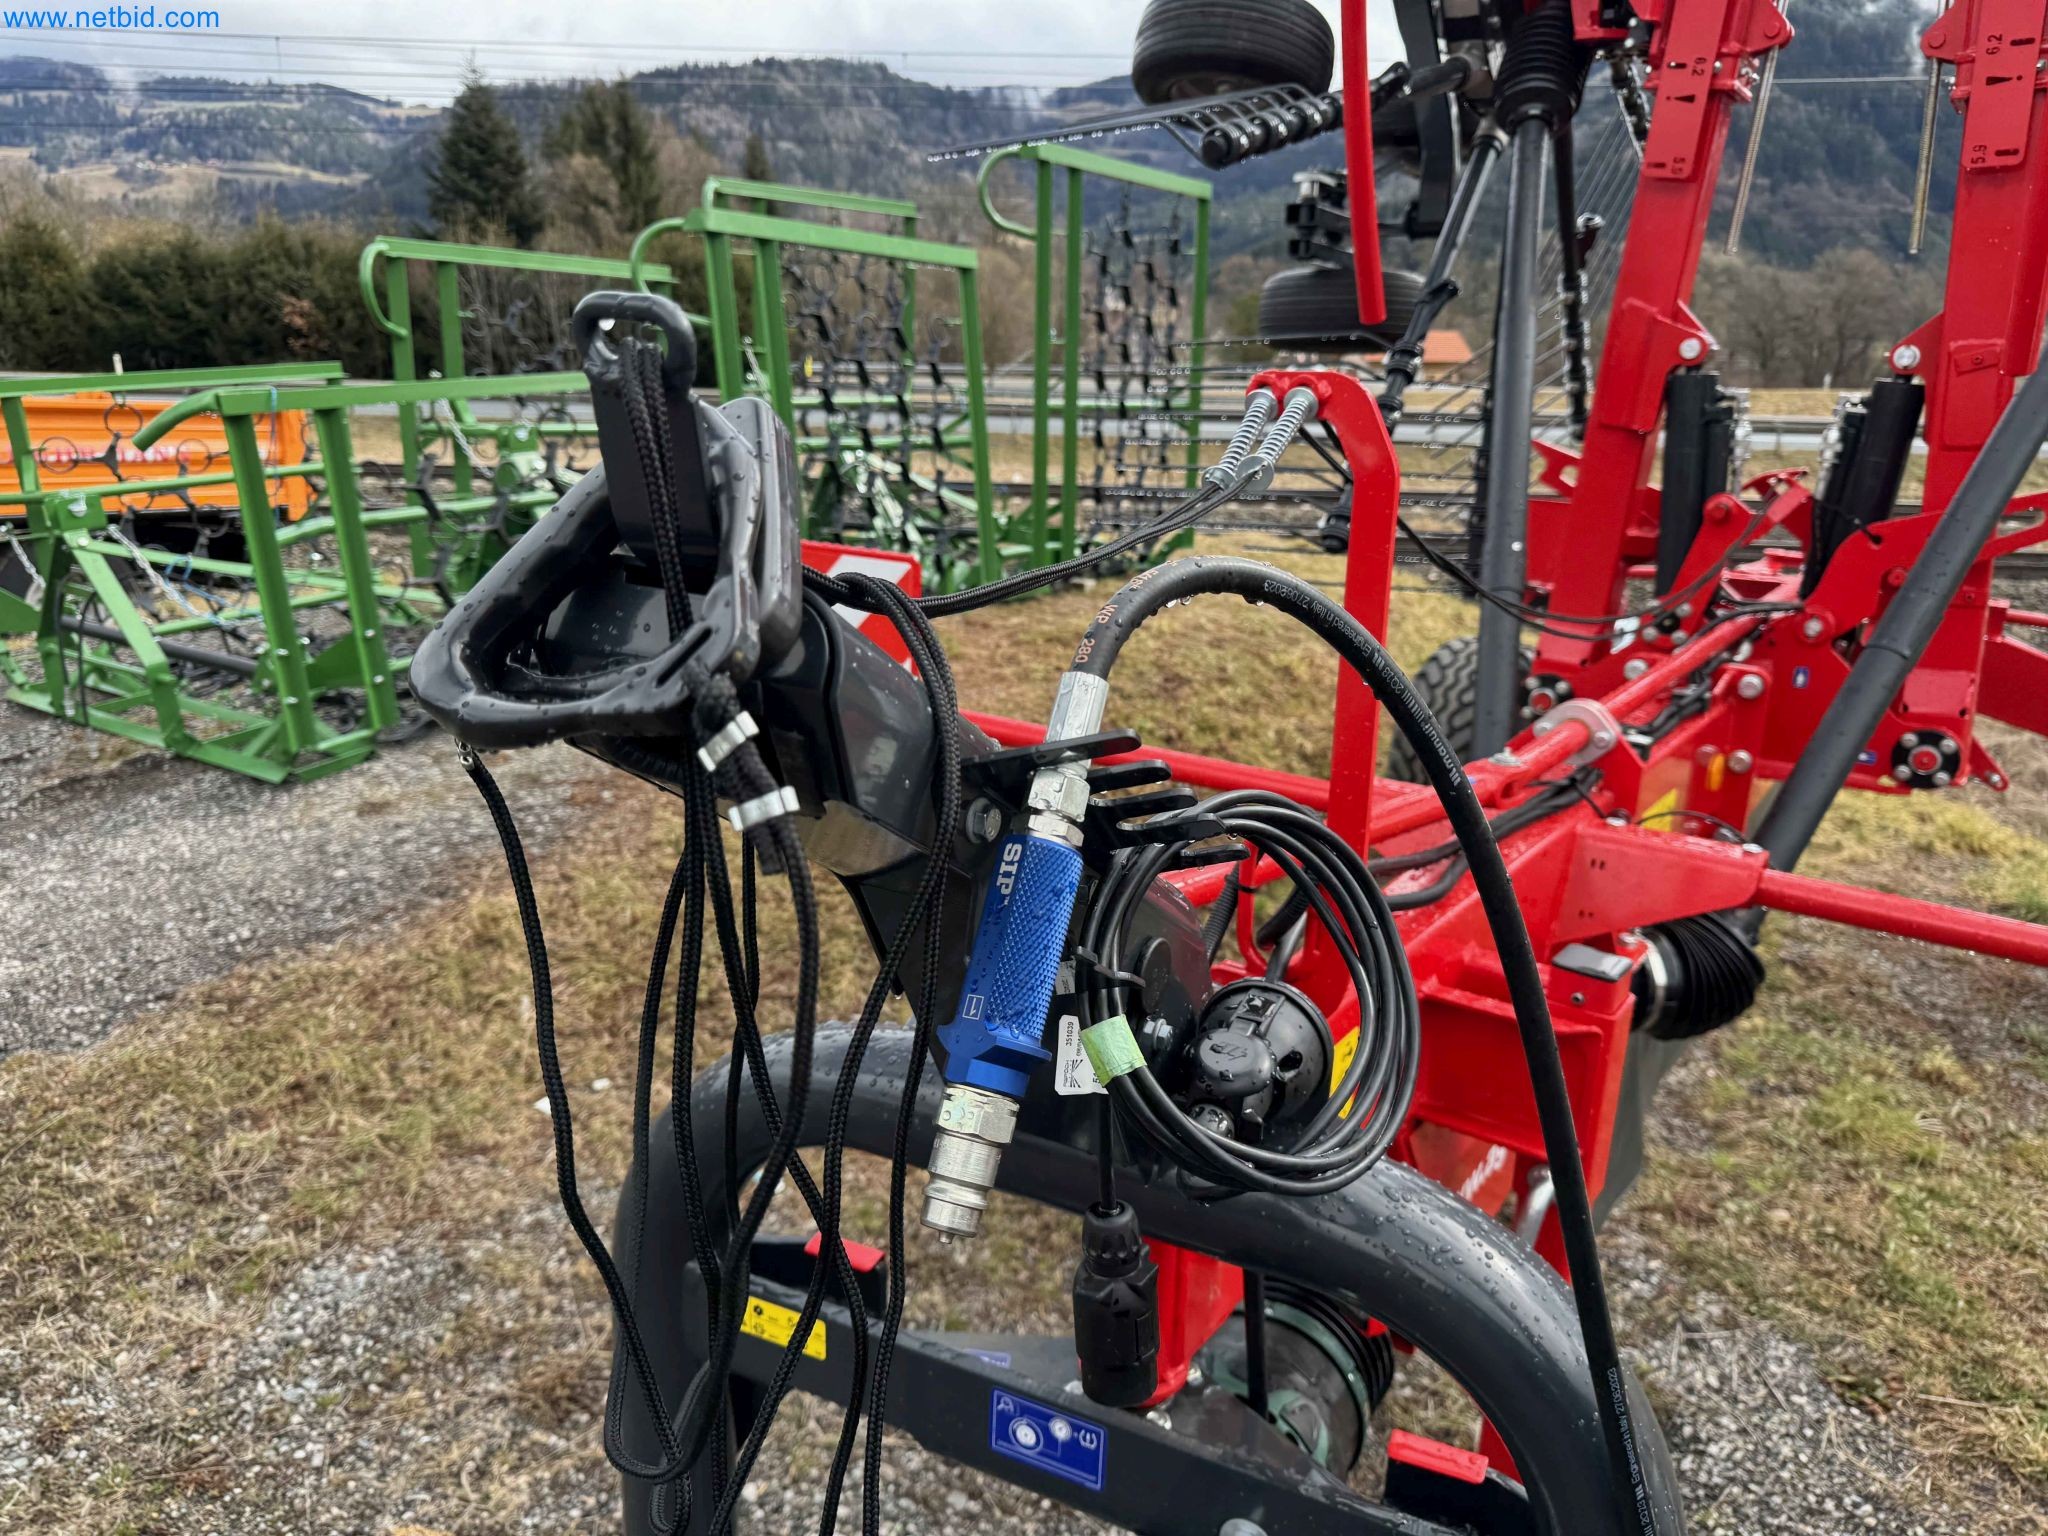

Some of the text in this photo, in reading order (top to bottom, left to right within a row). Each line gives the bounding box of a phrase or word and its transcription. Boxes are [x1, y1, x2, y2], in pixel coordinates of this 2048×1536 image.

[1986, 33, 2004, 55] 6.2
[1691, 56, 1708, 76] 6.2
[1311, 600, 1327, 620] Italy
[1075, 638, 1096, 663] 280
[996, 842, 1023, 898] SIP
